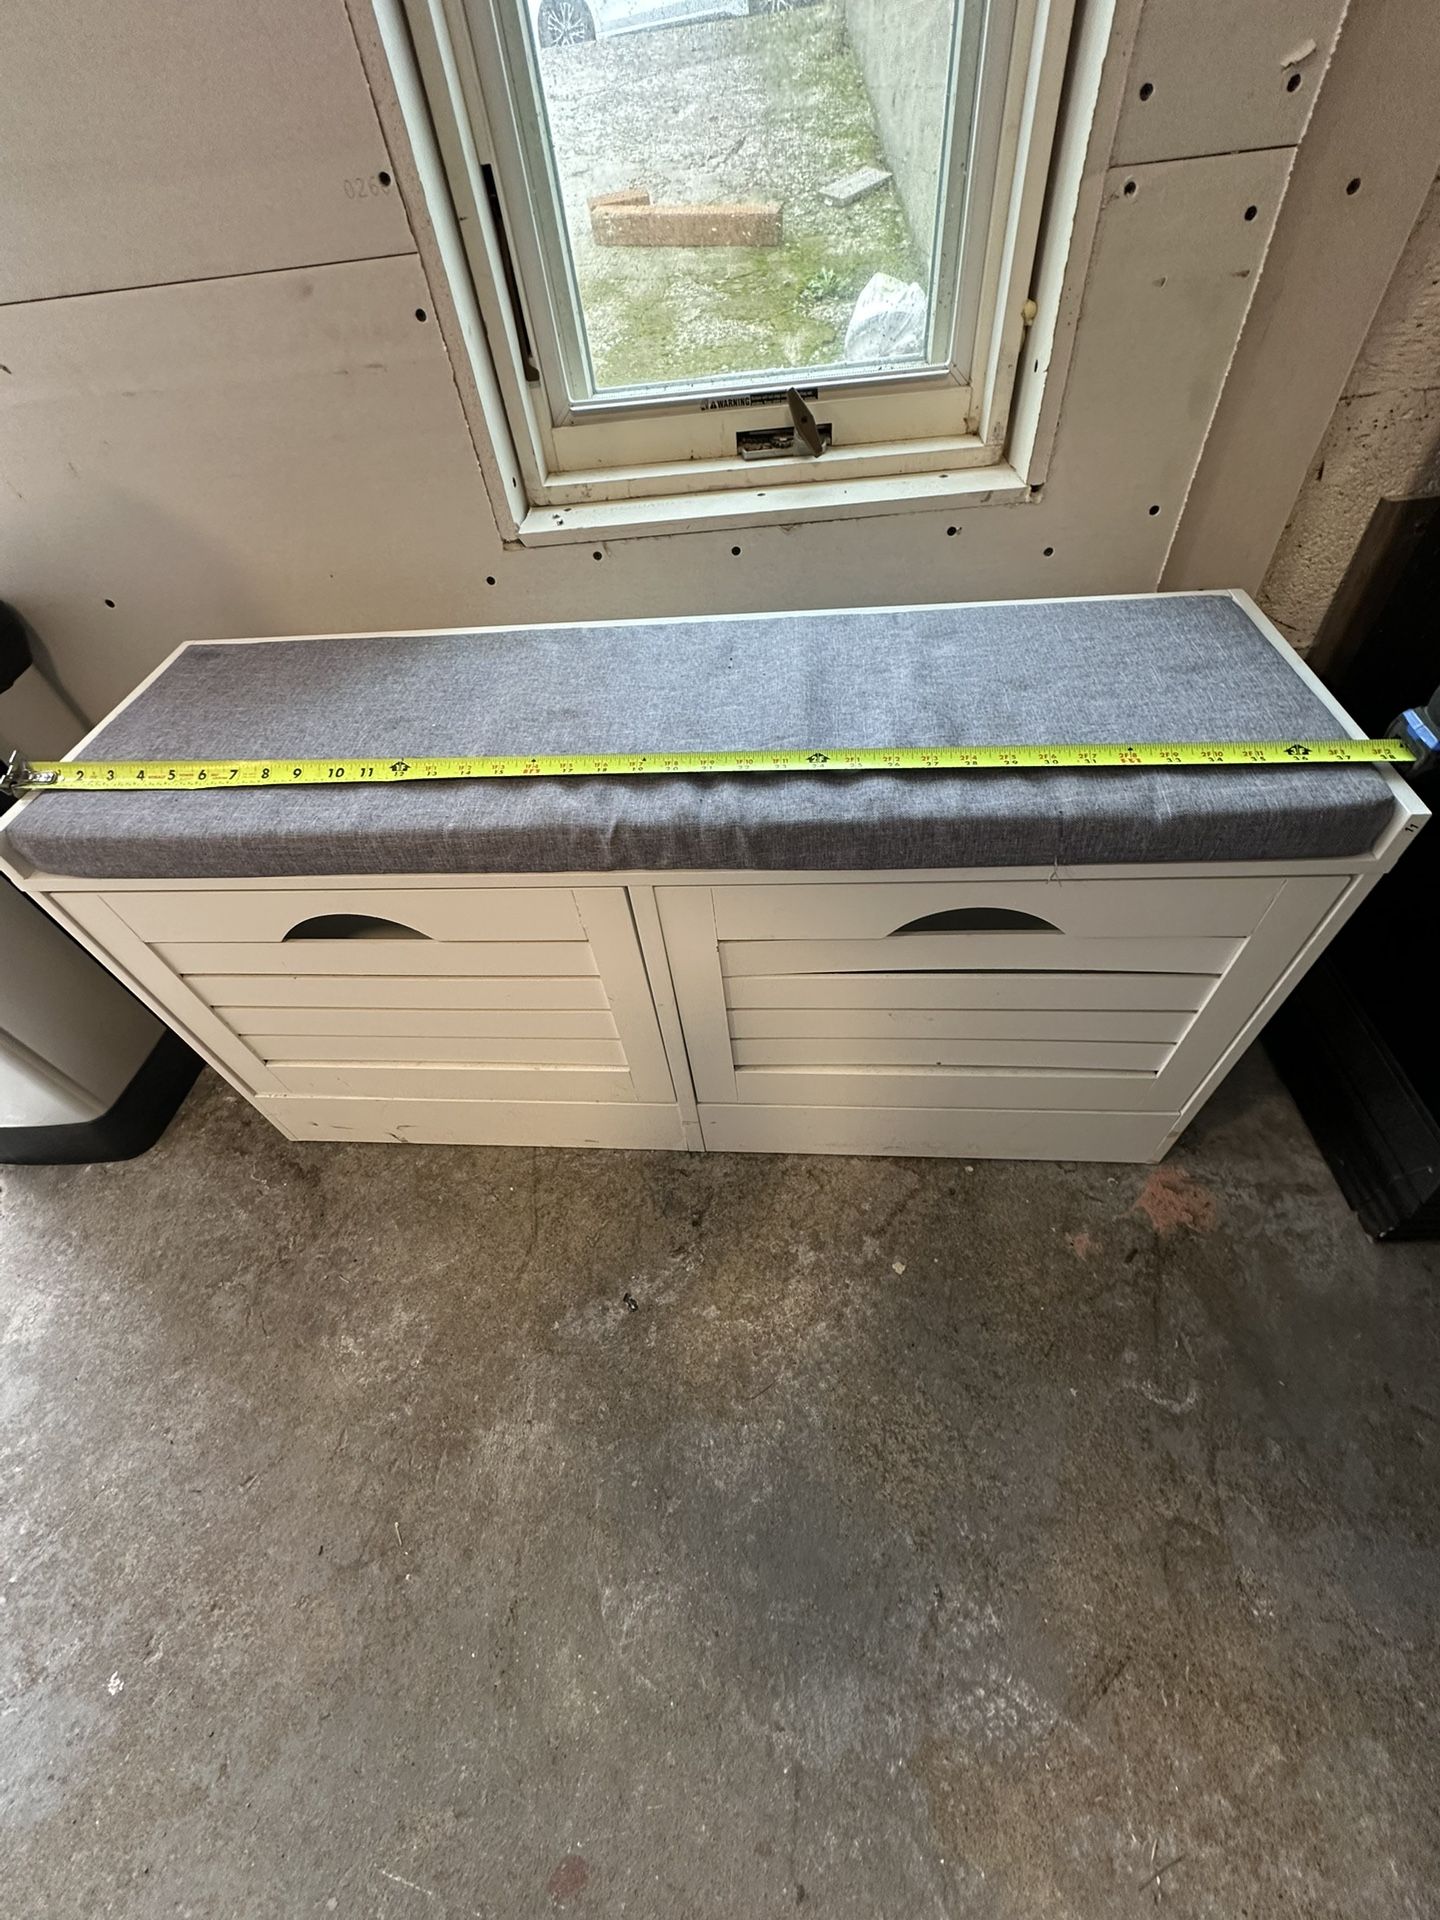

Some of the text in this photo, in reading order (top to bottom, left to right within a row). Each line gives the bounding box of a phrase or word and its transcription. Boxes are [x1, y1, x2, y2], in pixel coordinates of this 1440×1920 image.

[717, 397, 750, 408] WARNING
[76, 770, 84, 781] 2
[106, 770, 114, 781] 3
[136, 770, 145, 781] 4
[168, 770, 176, 780] 5
[198, 770, 207, 780] 6
[229, 769, 238, 780] 7
[261, 768, 270, 778] 8
[293, 768, 302, 778] 9
[328, 767, 345, 778] 10
[360, 767, 374, 777] 11
[1404, 823, 1419, 833] 11
